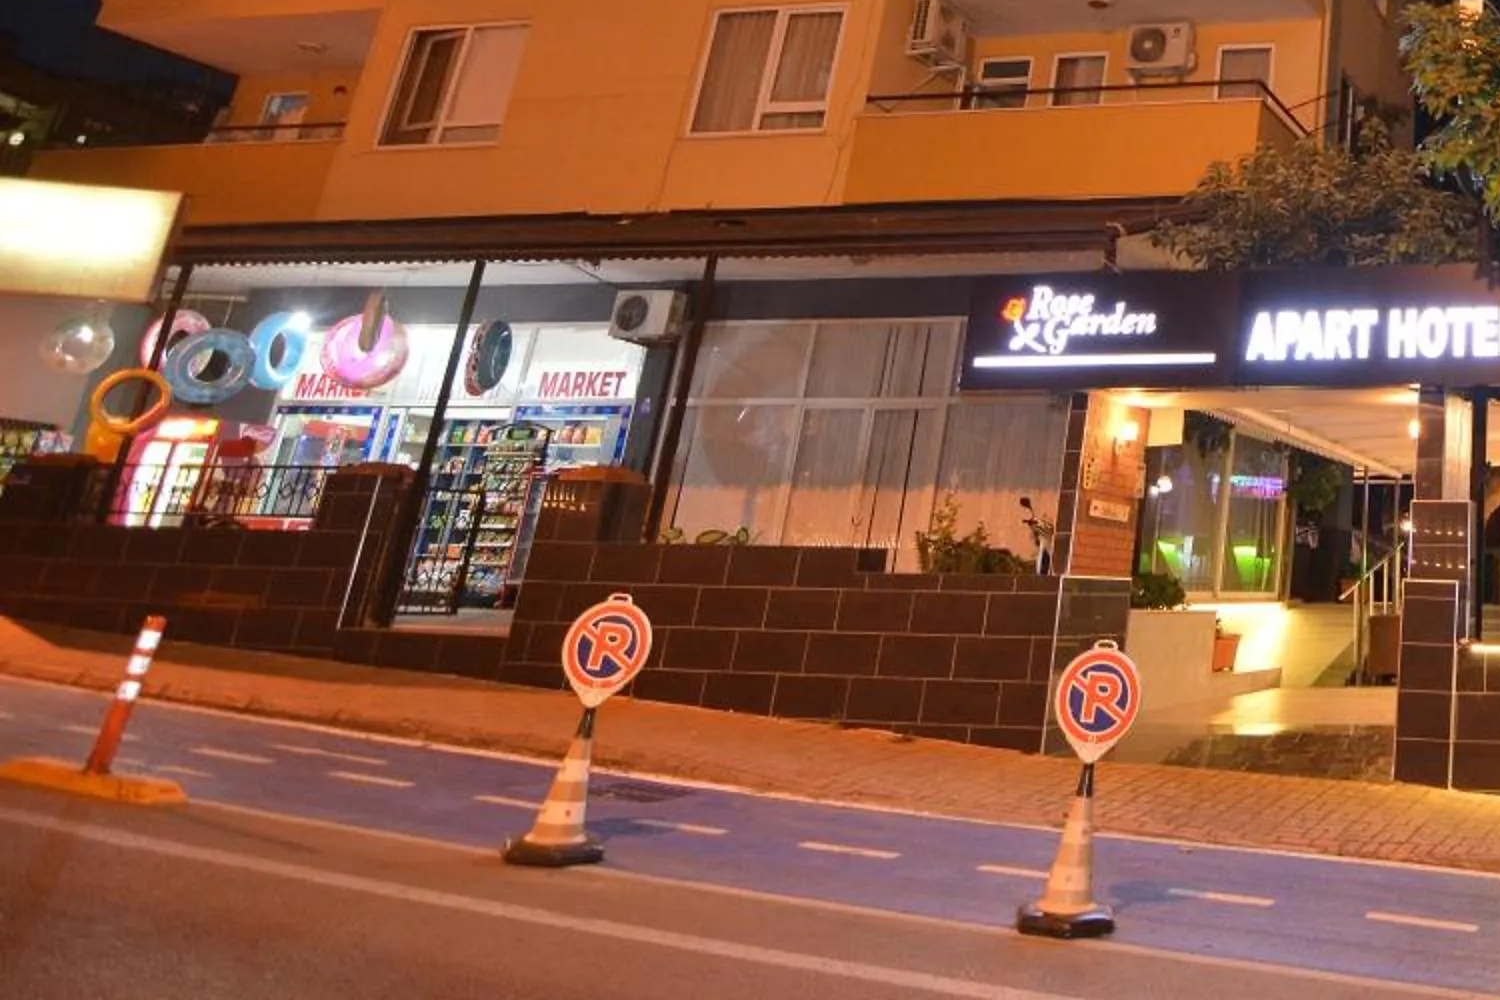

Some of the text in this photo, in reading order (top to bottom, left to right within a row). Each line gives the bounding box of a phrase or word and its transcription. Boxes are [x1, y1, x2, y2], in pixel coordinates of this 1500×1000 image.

[1026, 284, 1095, 321] Rose
[1043, 301, 1158, 355] Garden
[1245, 310, 1379, 361] APART
[538, 371, 627, 398] MARKET
